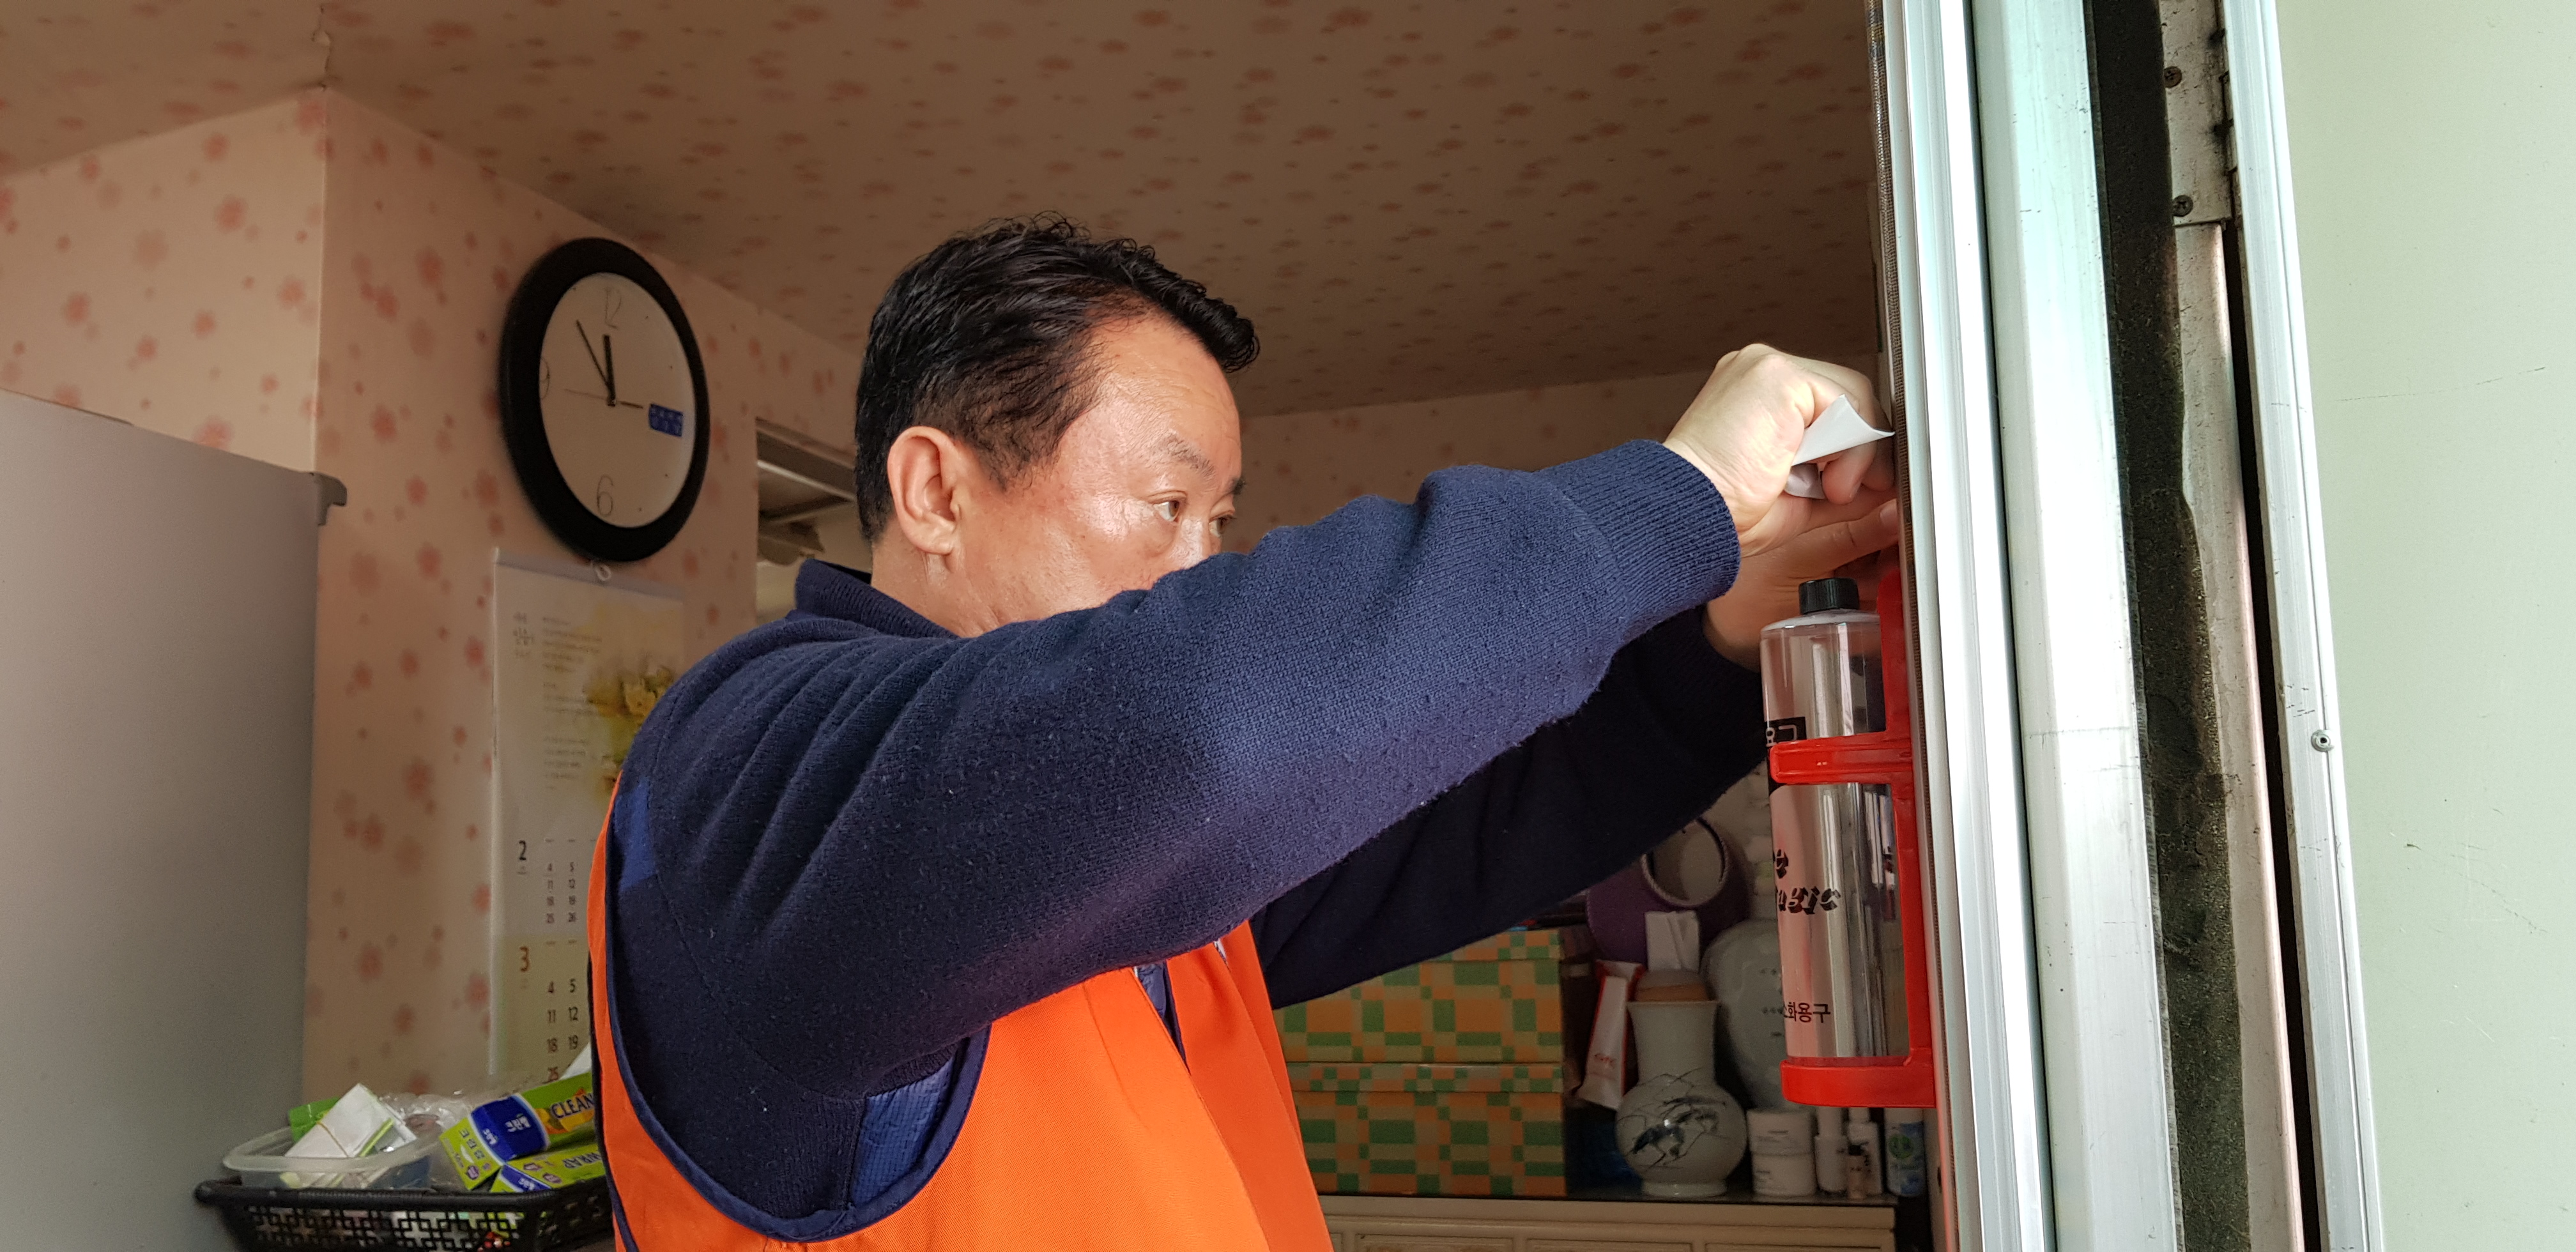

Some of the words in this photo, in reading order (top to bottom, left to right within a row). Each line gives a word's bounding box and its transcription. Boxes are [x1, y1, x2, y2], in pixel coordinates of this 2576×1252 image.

[604, 287, 622, 330] 12
[597, 475, 614, 517] 6
[519, 840, 526, 860] 2
[519, 945, 530, 972] 3
[548, 981, 554, 993] 4
[569, 979, 576, 993] 5
[548, 1009, 556, 1023] 11
[569, 1007, 578, 1021] 12
[548, 1038, 558, 1052] 18
[569, 1035, 578, 1050] 19
